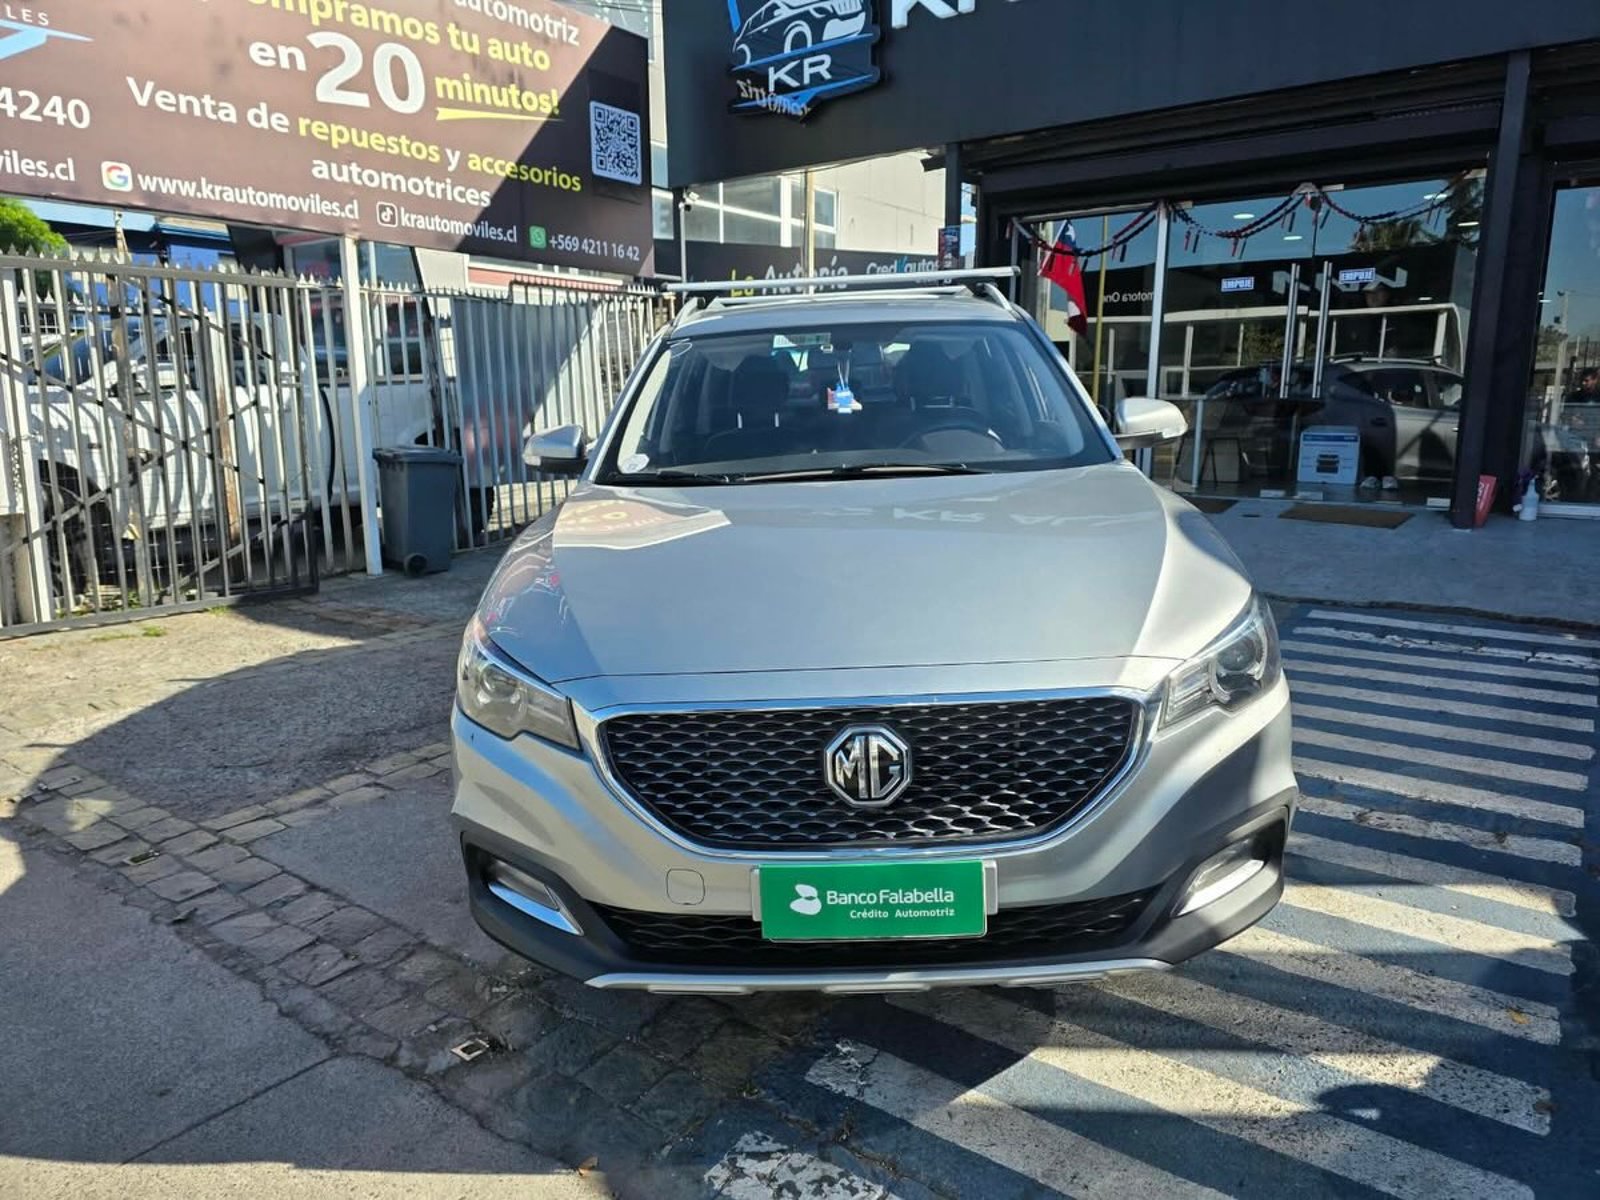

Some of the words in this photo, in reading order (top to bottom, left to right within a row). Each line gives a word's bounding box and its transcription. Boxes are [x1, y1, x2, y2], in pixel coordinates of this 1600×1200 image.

[446, 22, 480, 56] tu
[487, 37, 551, 72] auto
[248, 41, 307, 72] en
[306, 31, 426, 115] 20
[434, 73, 560, 116] minutos!
[768, 54, 832, 92] KR
[0, 86, 91, 130] 4240
[126, 75, 238, 124] Venta
[246, 102, 291, 133] de
[298, 116, 441, 164] repuestos
[446, 147, 461, 172] y
[467, 151, 583, 192] accesorios
[137, 172, 359, 219] www.krautomoviles.cl
[312, 158, 492, 208] automotrices
[400, 208, 518, 244] krautomoviles.cl
[549, 233, 580, 252] +569
[581, 237, 609, 257] 4211
[611, 242, 625, 259] 16
[626, 245, 641, 261] 42
[834, 732, 903, 801] MG
[826, 890, 877, 906] Banco
[879, 887, 954, 905] Falabella
[849, 907, 889, 919] Crédito
[894, 906, 955, 918] Automotriz
